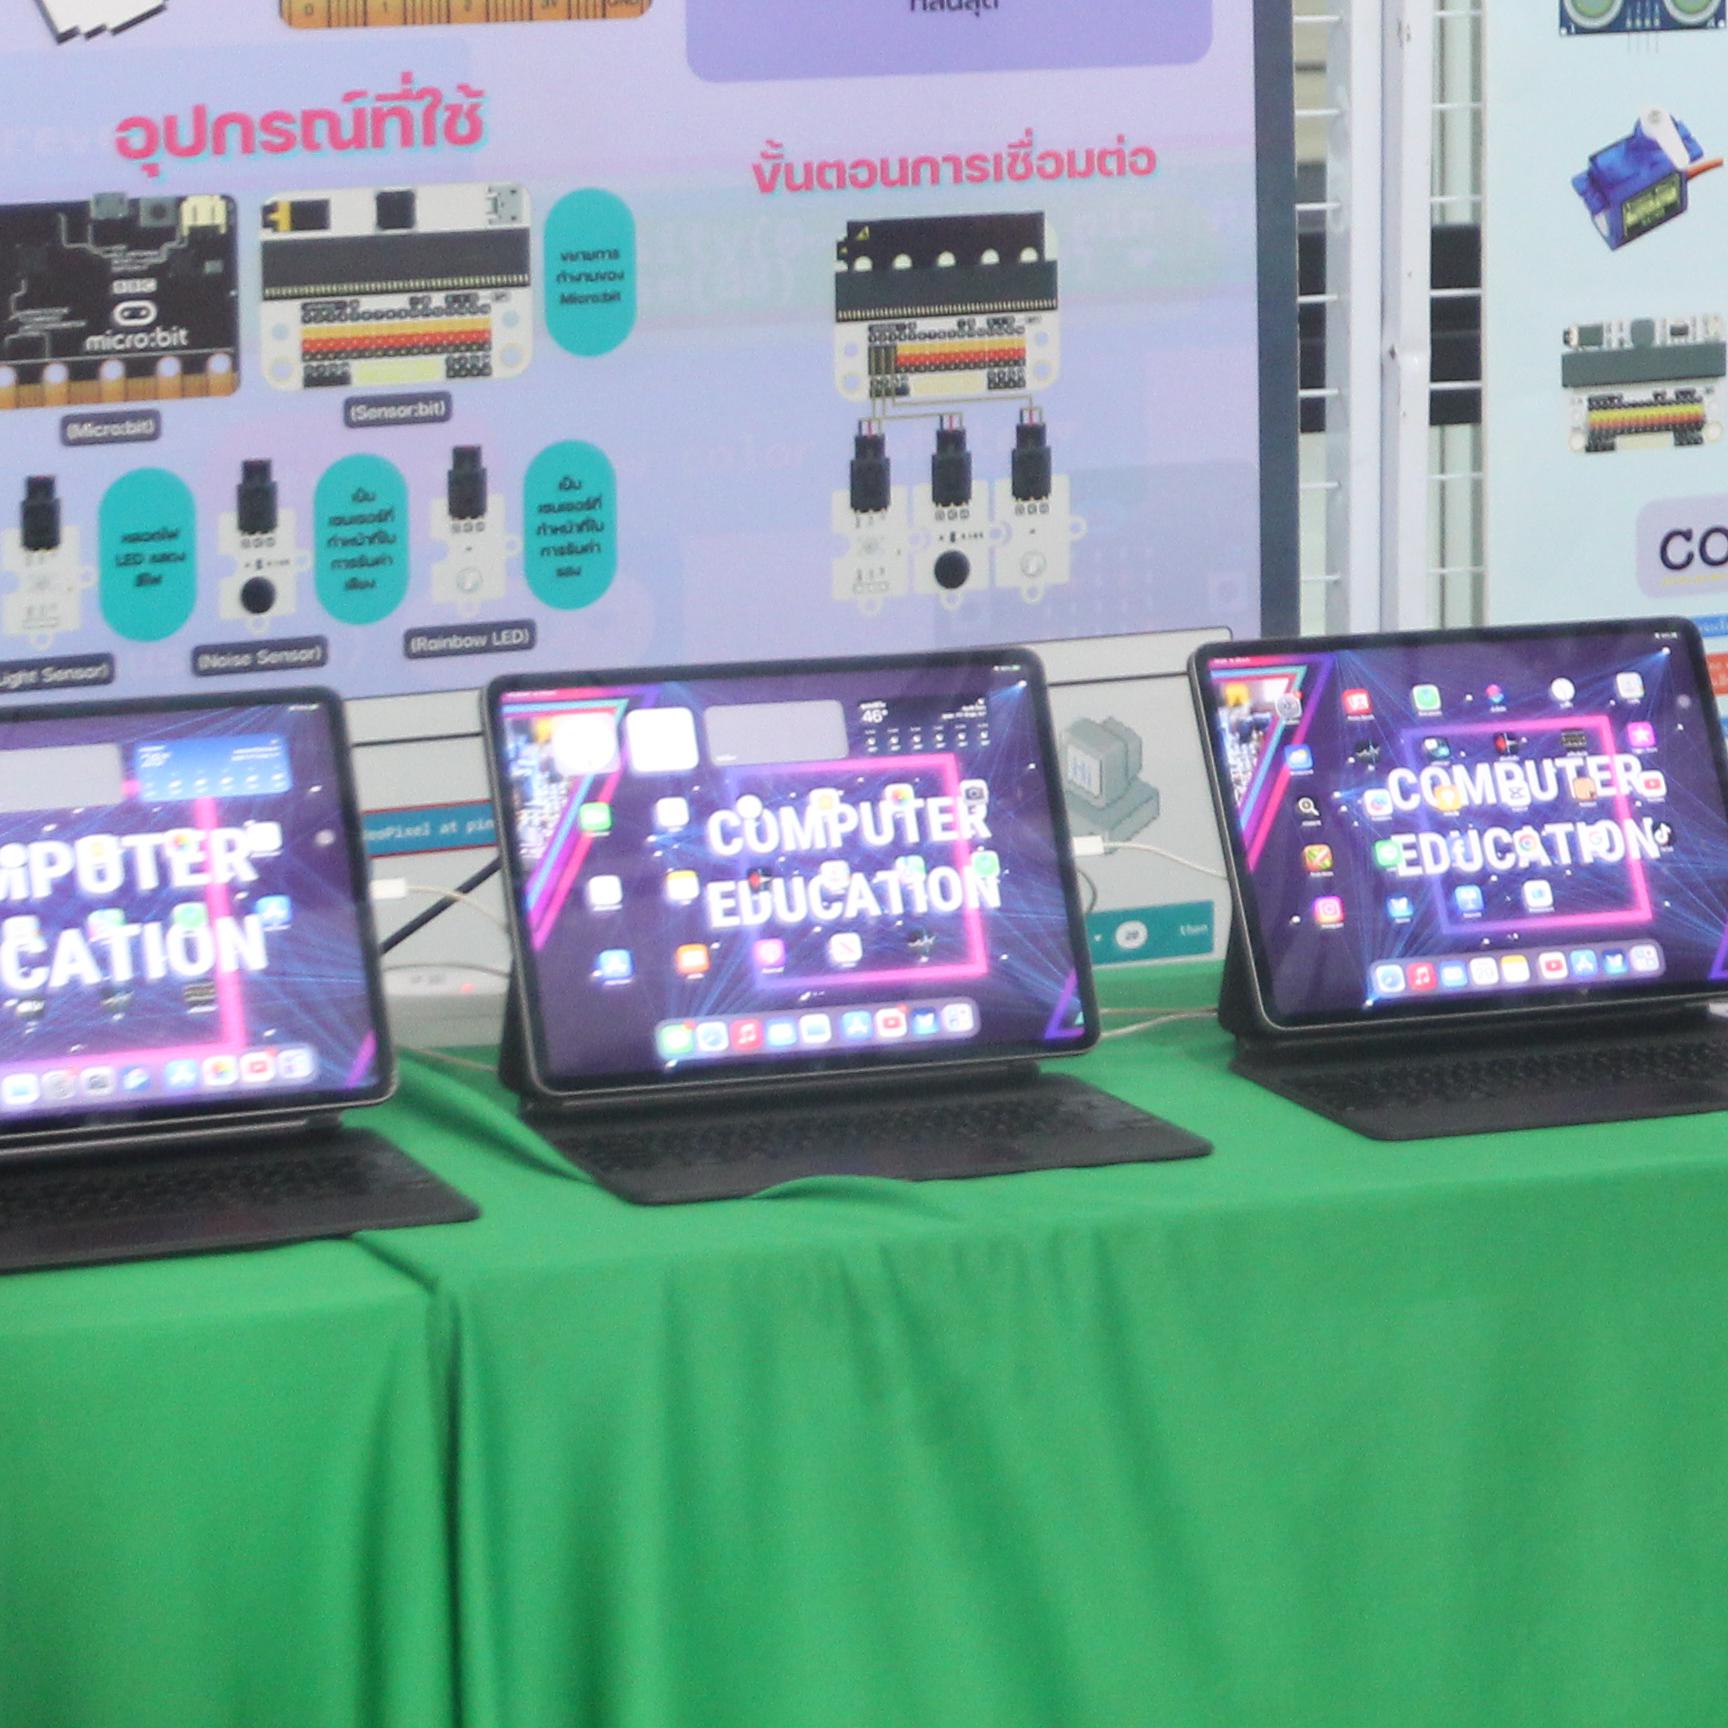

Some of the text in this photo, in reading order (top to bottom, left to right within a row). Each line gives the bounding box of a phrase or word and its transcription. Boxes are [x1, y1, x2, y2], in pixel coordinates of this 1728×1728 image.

[115, 71, 486, 177] อุปกรณ์ที่ใช้
[753, 128, 1158, 195] ขั้นตอนการเชื่อมต่อ
[85, 325, 189, 352] micro:bit
[350, 399, 447, 423] (Sensor:bit)
[410, 629, 530, 654] (Rainbow LED)
[707, 790, 993, 858] COMPUTER
[1390, 817, 1661, 878] EDUCATION
[708, 865, 1002, 929] EDUCATION
